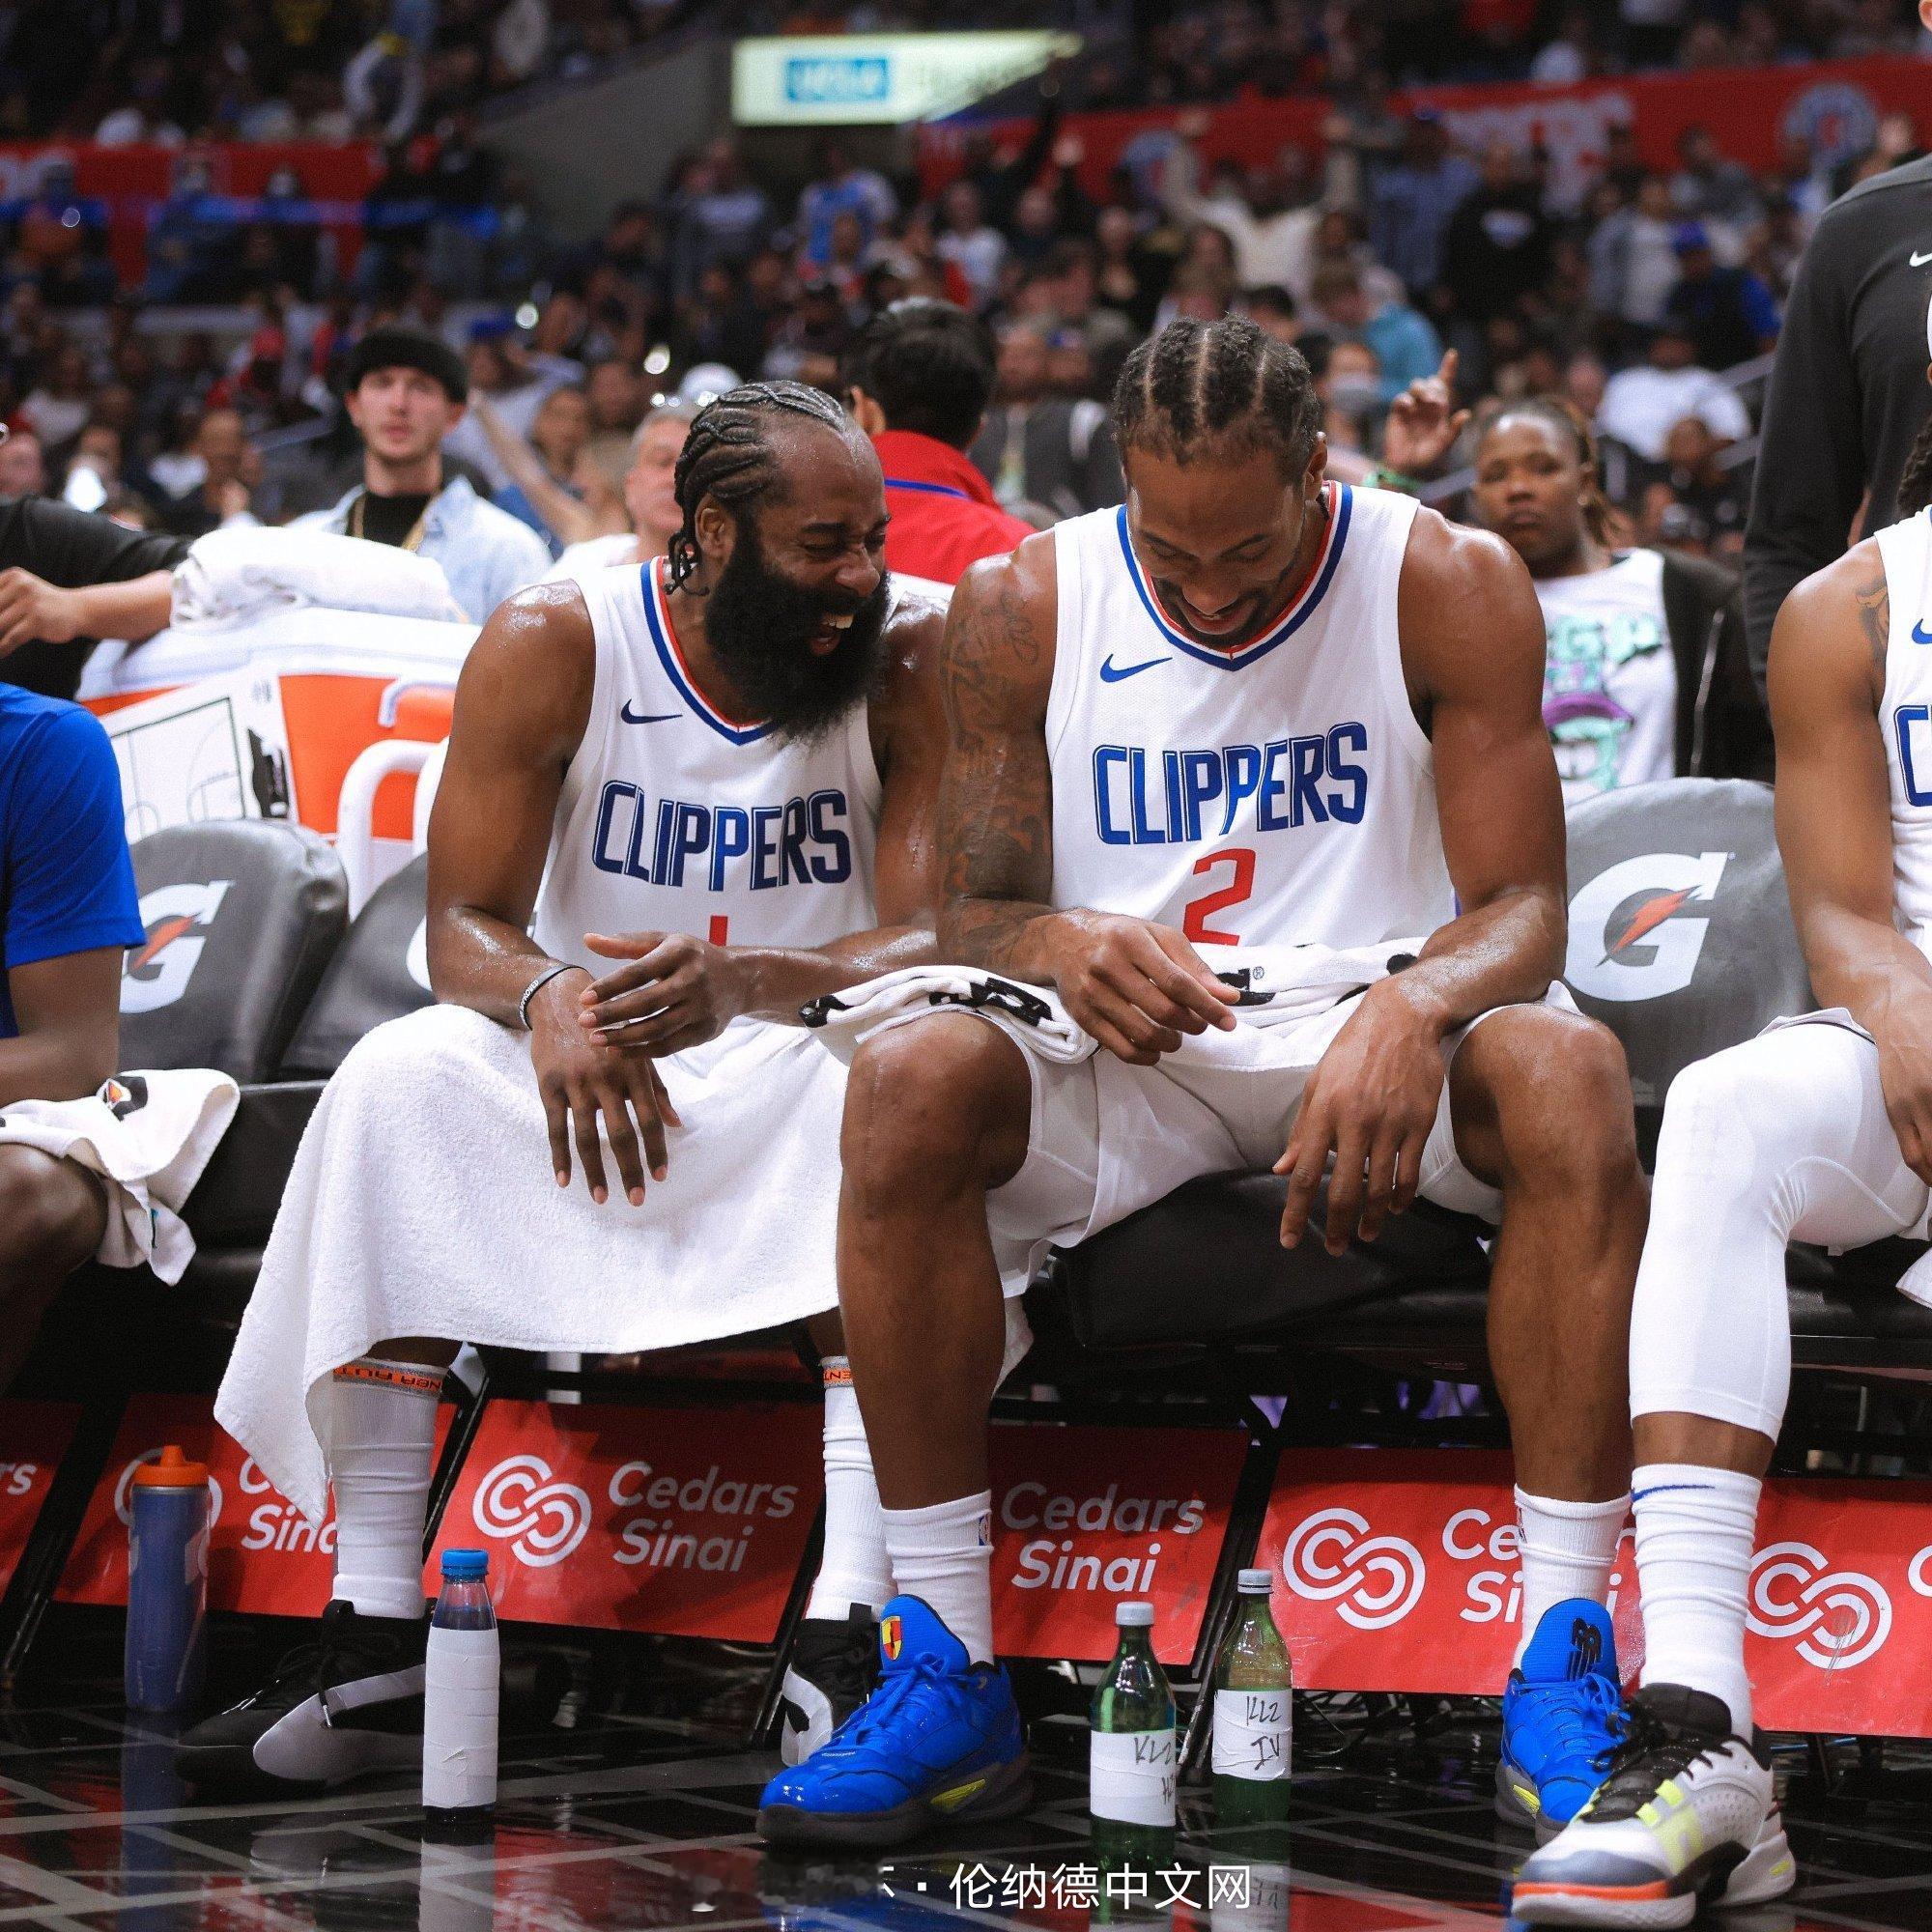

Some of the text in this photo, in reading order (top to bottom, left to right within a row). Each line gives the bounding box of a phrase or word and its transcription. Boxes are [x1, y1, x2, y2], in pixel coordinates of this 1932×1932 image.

[1093, 722, 1368, 845] CLIPPERS
[592, 780, 851, 891] CLIPPERS
[1182, 848, 1256, 947] 2
[608, 1461, 799, 1518] Cedars
[1001, 1482, 1207, 1534] Cedars
[612, 1518, 754, 1573] Sinai
[1010, 1540, 1161, 1592] Sinai
